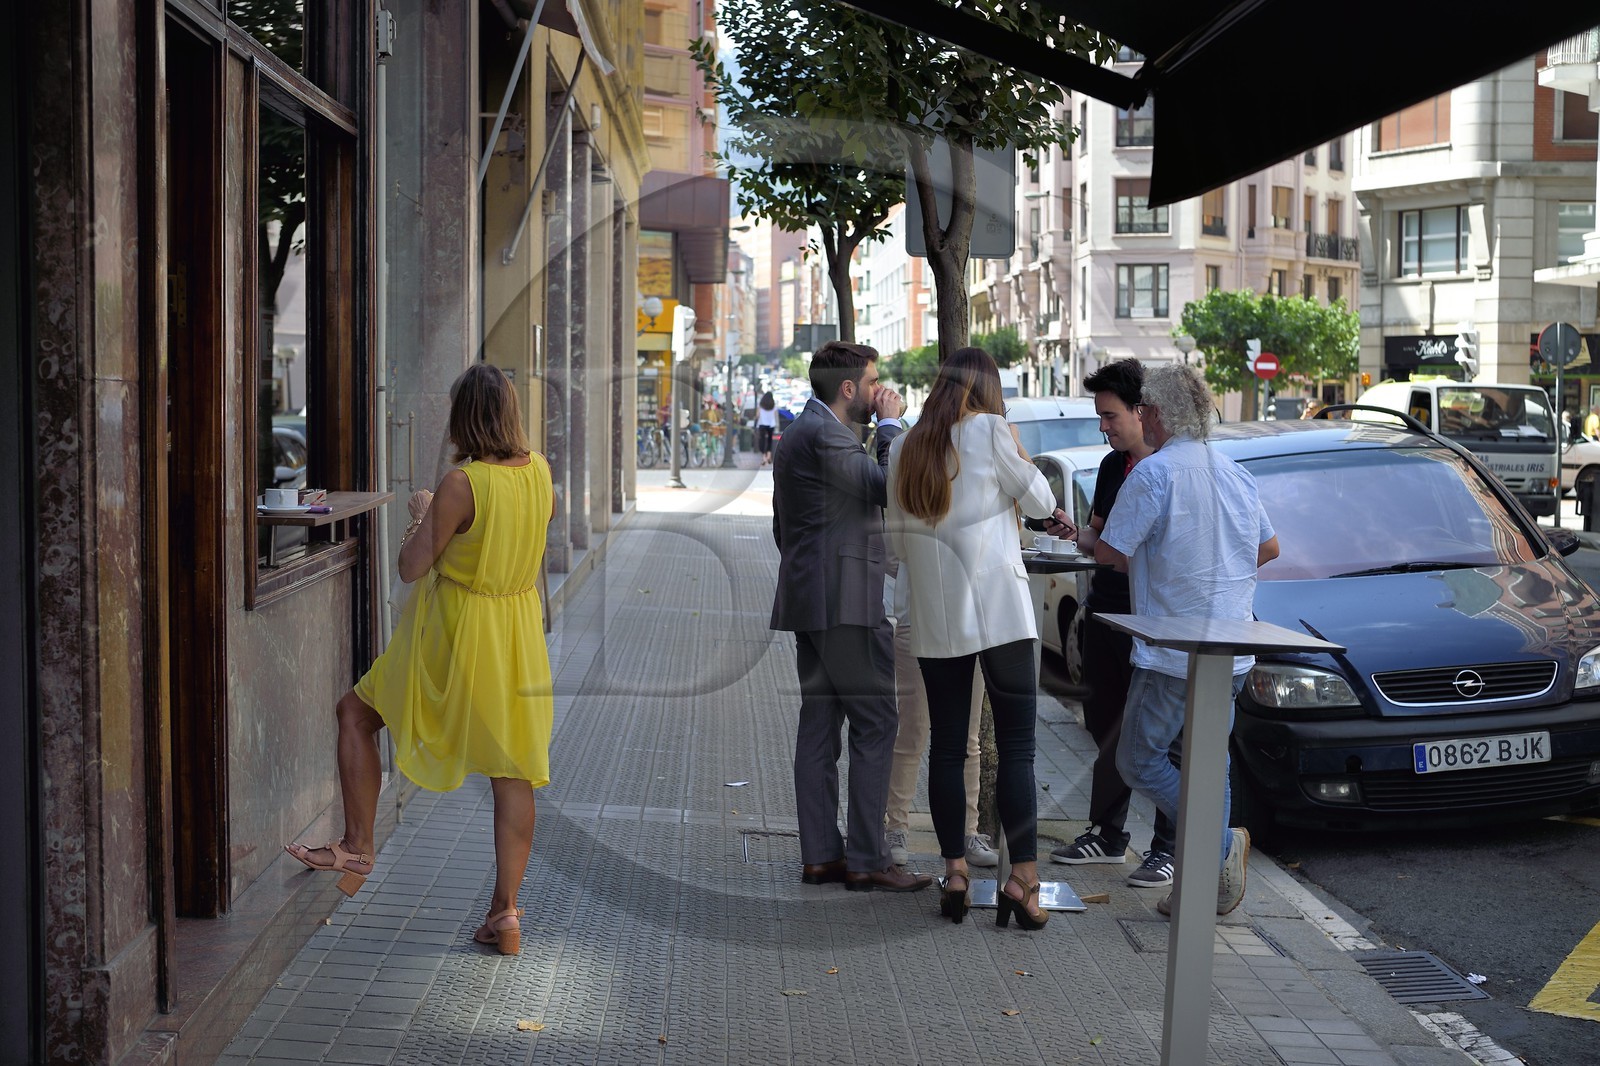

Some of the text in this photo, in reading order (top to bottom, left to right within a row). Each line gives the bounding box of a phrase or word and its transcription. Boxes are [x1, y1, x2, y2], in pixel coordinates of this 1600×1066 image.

[1526, 463, 1545, 472] IRIS
[1428, 736, 1544, 767] 0862 BJK
